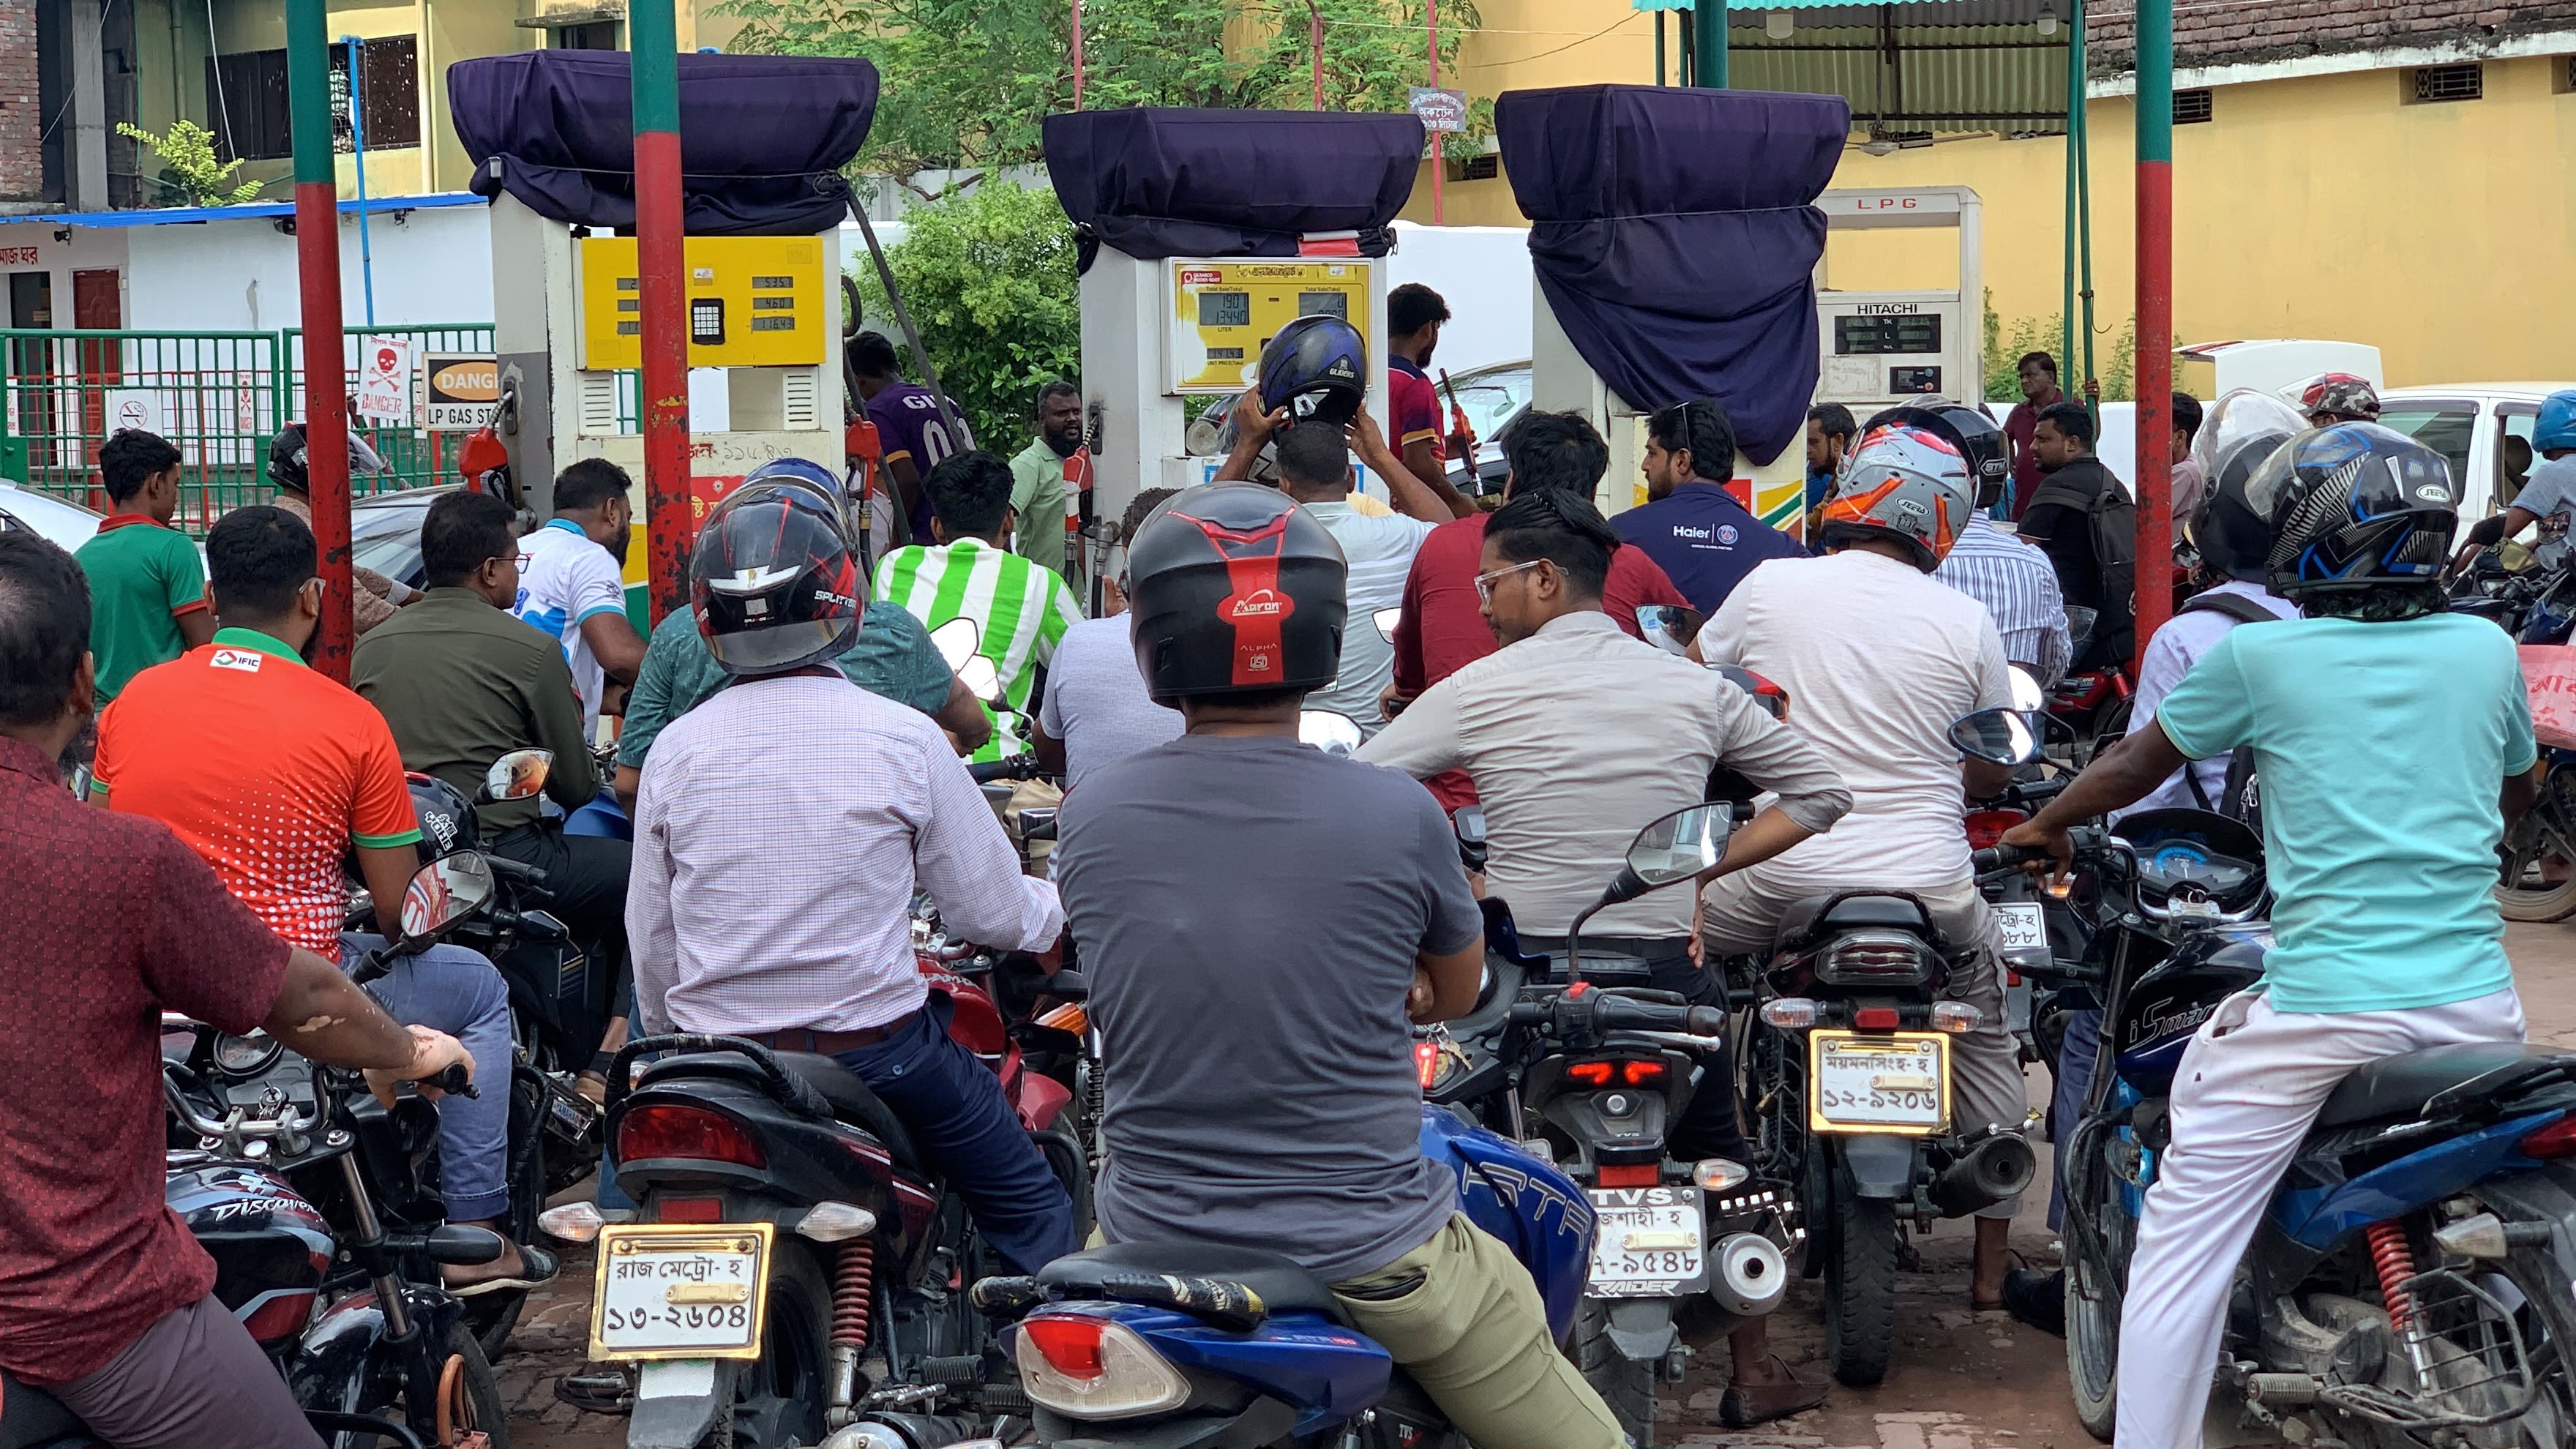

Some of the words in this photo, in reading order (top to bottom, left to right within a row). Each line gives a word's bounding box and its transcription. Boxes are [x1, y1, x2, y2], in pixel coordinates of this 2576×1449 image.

[1418, 106, 1454, 118] অকটেন
[1858, 198, 1917, 209] LPG
[20, 246, 39, 265] ঘর
[1857, 304, 1917, 314] HITACHI
[362, 393, 402, 414] DANGER
[428, 408, 443, 424] LP
[449, 408, 472, 424] GAS
[477, 408, 492, 424] ST
[1673, 525, 1710, 539] Haier
[1232, 599, 1279, 615] Aaron
[1240, 643, 1278, 651] ALPHA
[238, 656, 259, 667] IFIC
[2124, 996, 2220, 1053] iSmar
[1824, 1089, 1936, 1110] ১২-৯২০৬
[1588, 1188, 1673, 1206] TVS
[616, 1261, 656, 1279] রাজ
[728, 1259, 744, 1278] হ
[1594, 1251, 1699, 1275] ২-৯৫৪৮
[1590, 1281, 1681, 1298] RAIDER
[607, 1305, 747, 1331] ১৩-২৬০৪
